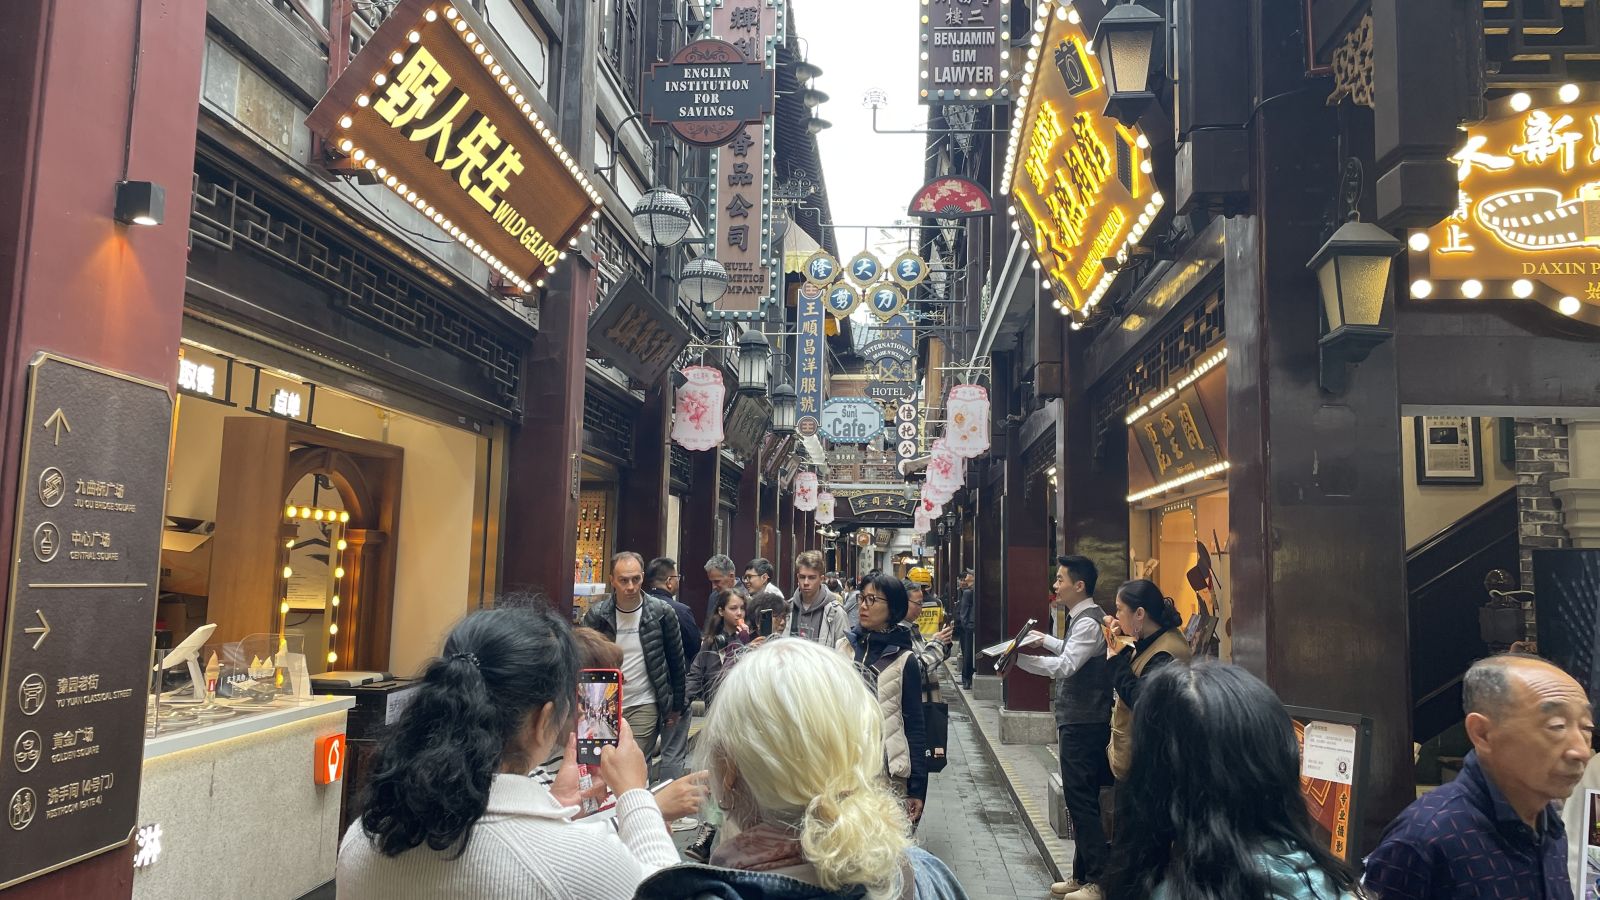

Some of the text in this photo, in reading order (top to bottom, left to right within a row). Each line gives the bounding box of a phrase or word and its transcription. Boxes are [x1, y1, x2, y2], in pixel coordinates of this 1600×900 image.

[934, 32, 995, 45] BENJAMIN
[952, 49, 976, 62] GIM
[684, 67, 731, 79] ENGLIN
[934, 66, 994, 83] LAWYER
[665, 80, 749, 92] INSTITUTION
[694, 93, 720, 104] FOR
[679, 105, 734, 117] SAVINGS
[374, 46, 525, 213] 野人先生
[1447, 111, 1600, 181] 大新
[493, 200, 559, 268] WILD GELATO
[1522, 262, 1585, 275] DAXIN
[728, 274, 764, 283] METICS
[727, 285, 763, 294] MPANY
[800, 302, 819, 413] 王順昌洋服號
[864, 342, 912, 356] INTERNATIONAL
[872, 387, 905, 396] HOTEL
[832, 417, 866, 437] Cafe
[75, 478, 125, 499] 九曲桥广场
[84, 500, 94, 508] QU
[94, 501, 114, 511] BRIDGE
[114, 503, 136, 513] SQUARE
[71, 530, 111, 548] 中心广场
[70, 551, 119, 560] CENTRAL SQUARE
[56, 673, 99, 695] 豫园老街
[56, 688, 133, 708] YU YUAN CLASSICAL STREET
[52, 727, 94, 750] 黄金广场
[51, 745, 100, 763] GOLDEN SQUARE
[48, 782, 80, 806] 洗手间
[46, 802, 78, 819] RESTROOM
[1335, 793, 1348, 853] 专业摄影
